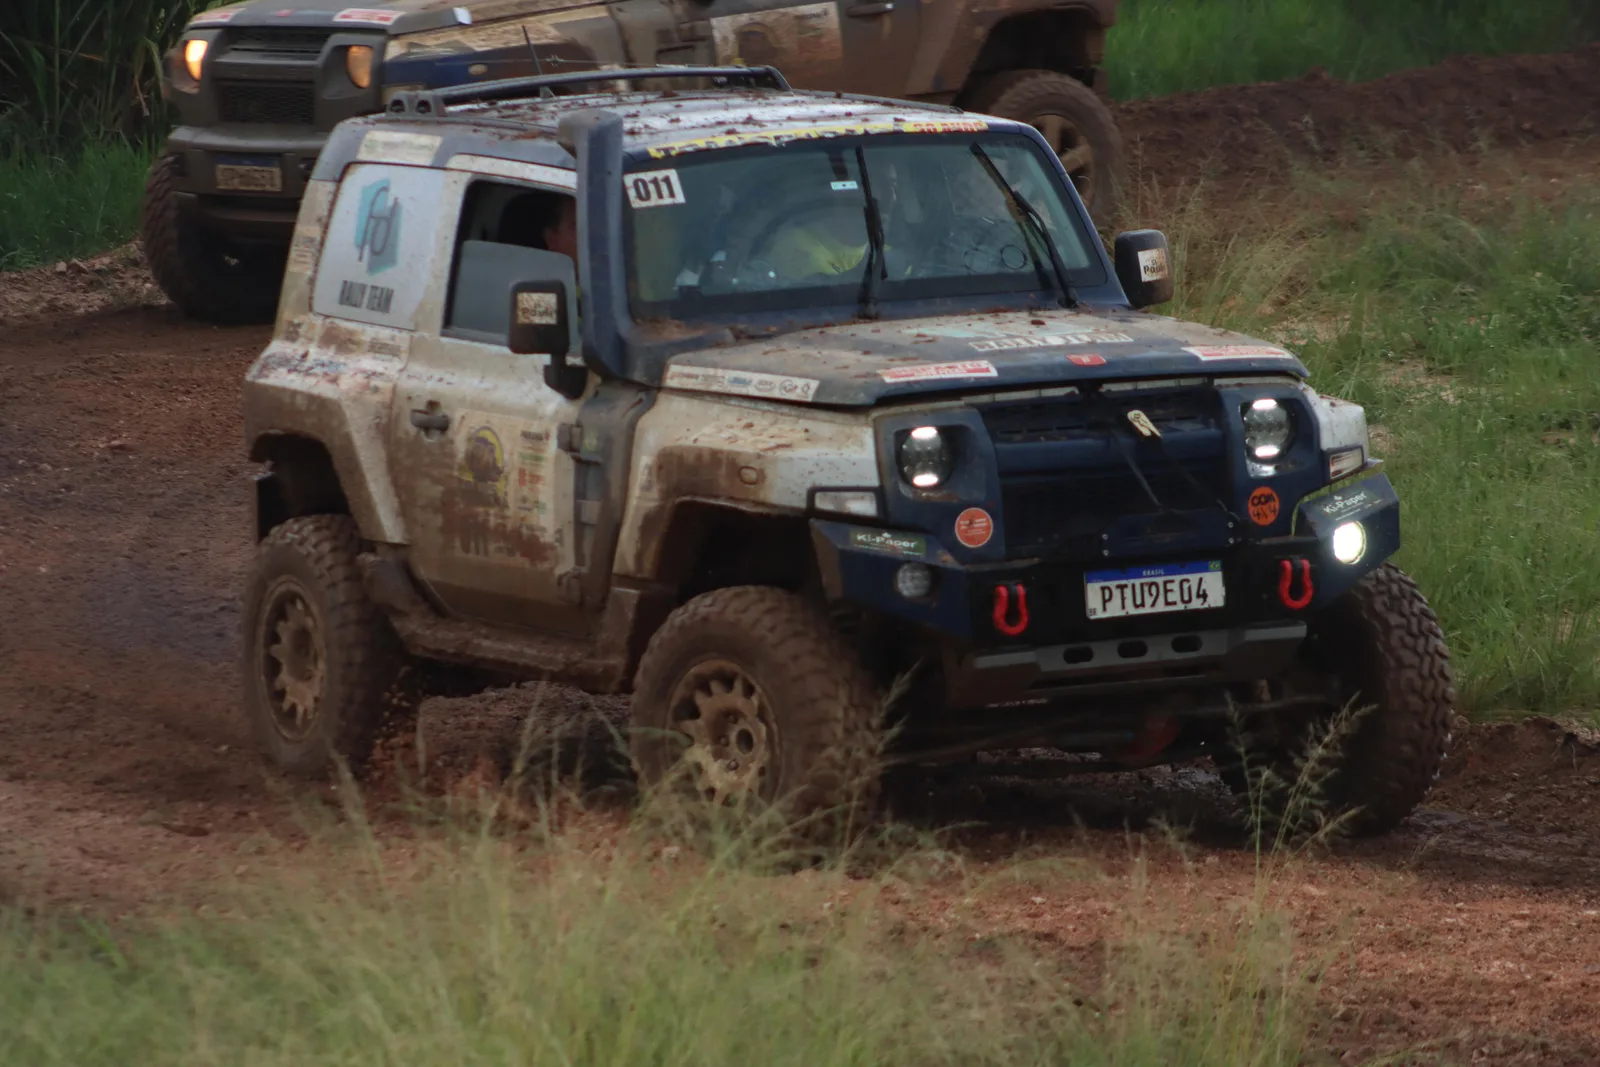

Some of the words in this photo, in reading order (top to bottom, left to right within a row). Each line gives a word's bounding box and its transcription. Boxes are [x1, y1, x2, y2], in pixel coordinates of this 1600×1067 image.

[632, 174, 676, 202] 011
[338, 279, 367, 309] RALLY
[366, 284, 395, 315] TEAM
[1323, 491, 1367, 513] Ki-Paper
[1142, 568, 1165, 577] BRASIL
[1099, 576, 1209, 613] PTU9E04
